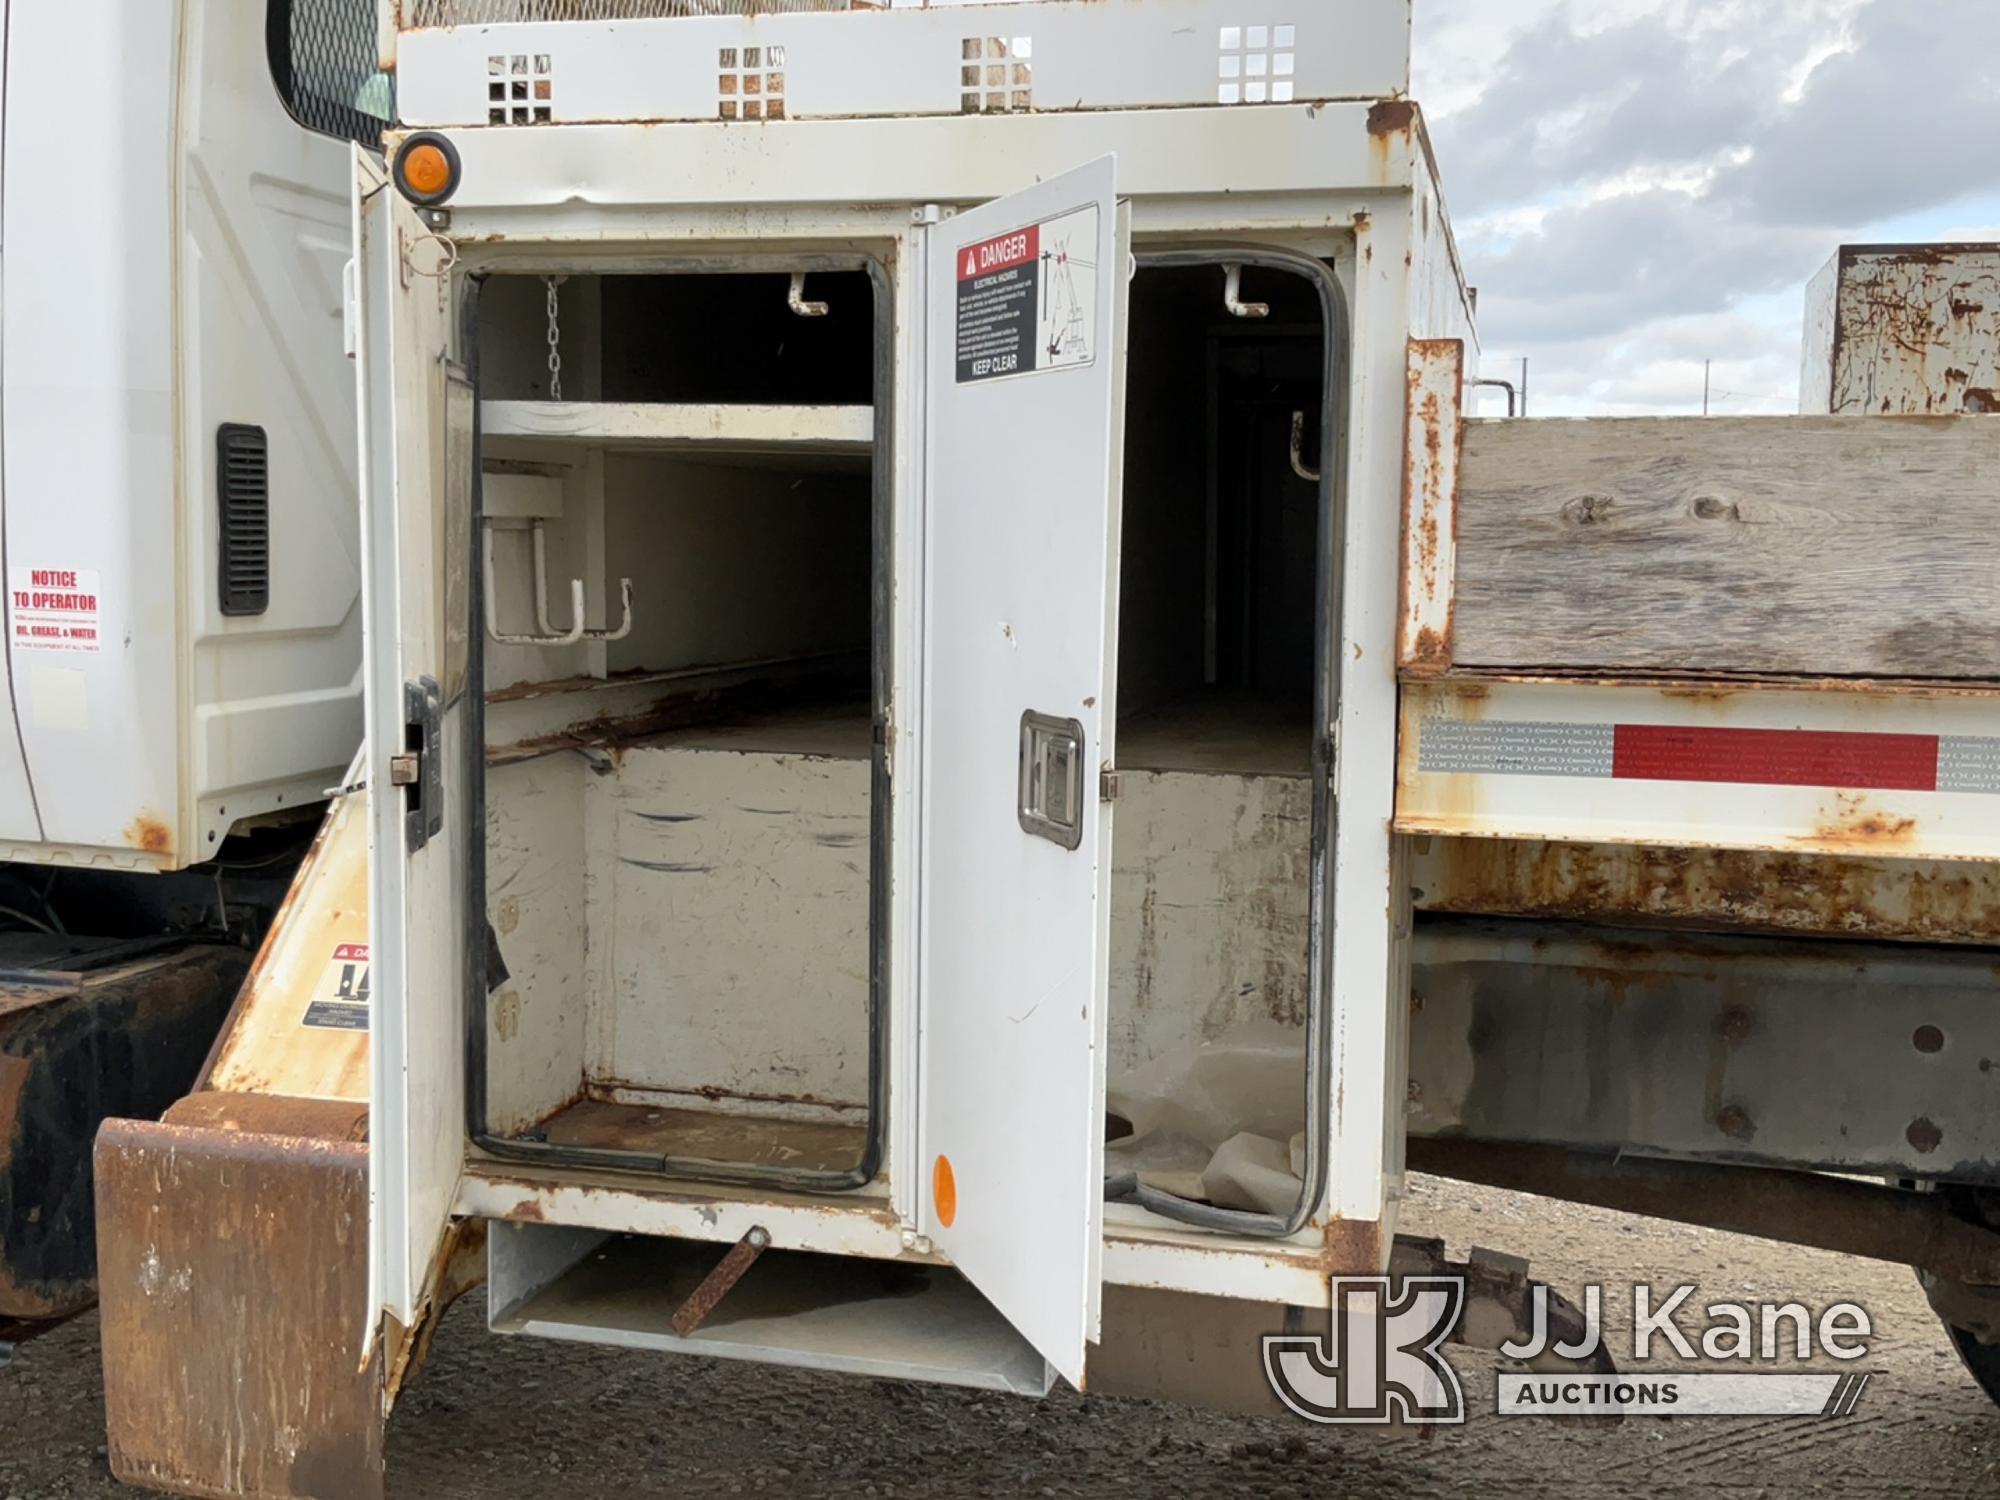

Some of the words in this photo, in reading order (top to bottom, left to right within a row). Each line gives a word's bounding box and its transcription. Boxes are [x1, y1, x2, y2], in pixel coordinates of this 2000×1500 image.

[980, 234, 1027, 268] DANGER
[972, 357, 993, 376] KEEP
[993, 354, 1018, 374] CLEAR
[31, 570, 77, 587] NOTICE
[13, 591, 29, 607] TO
[32, 592, 96, 610] OPERATOR
[70, 628, 96, 640] WATER
